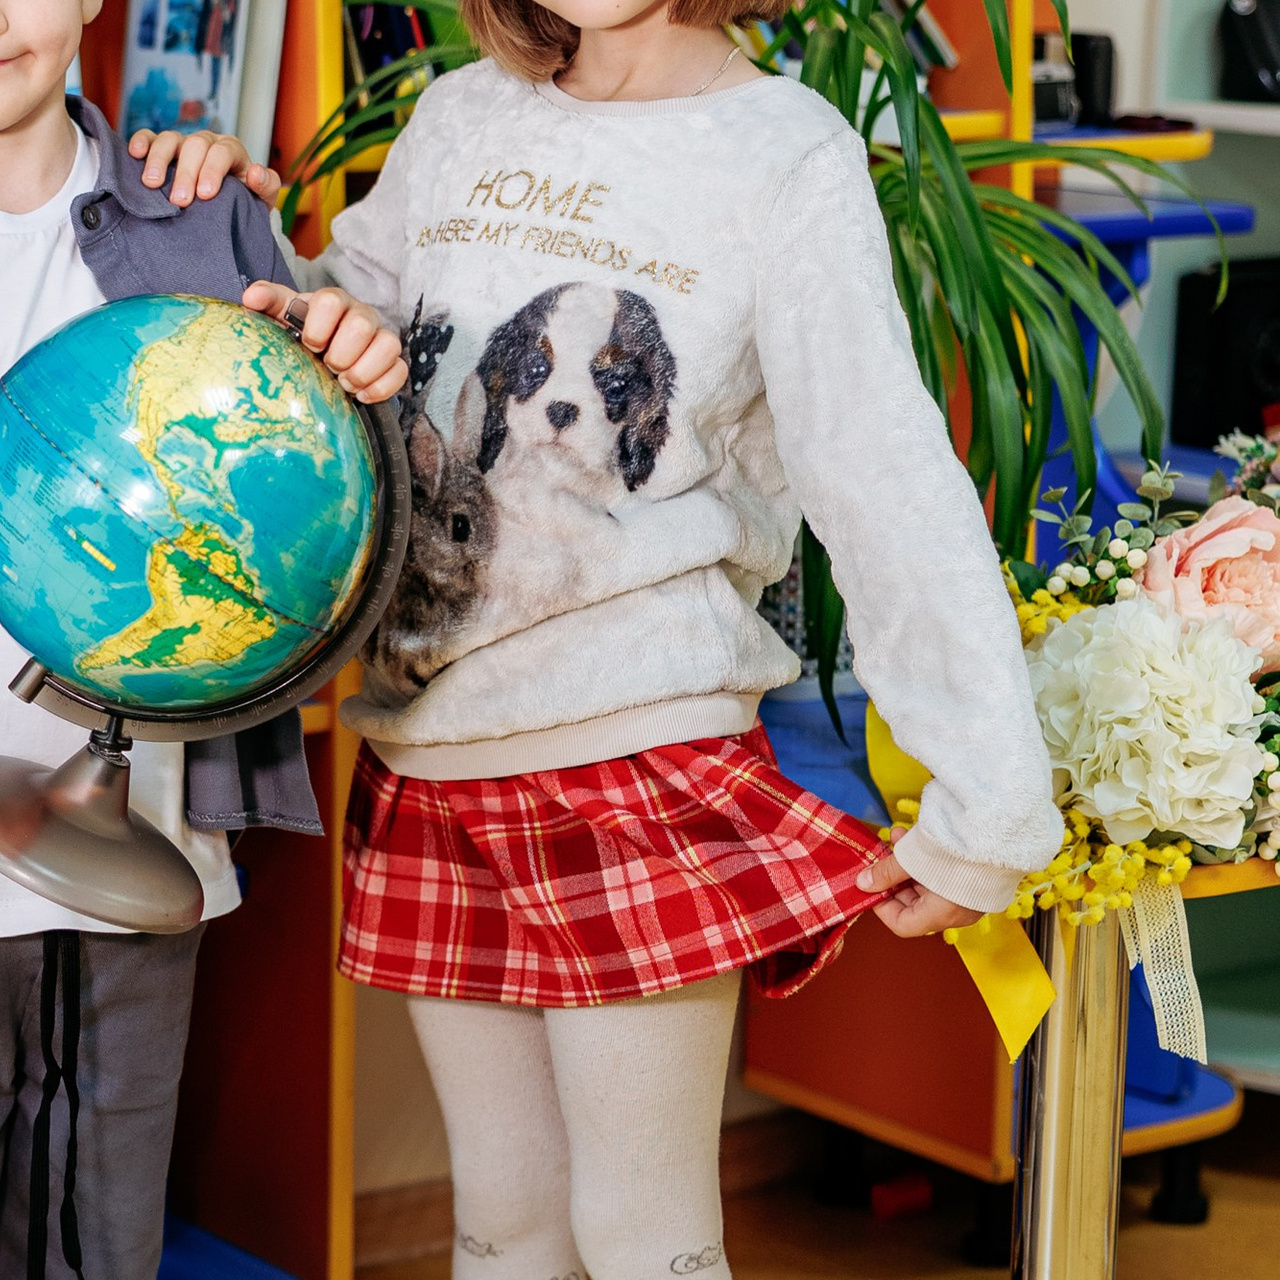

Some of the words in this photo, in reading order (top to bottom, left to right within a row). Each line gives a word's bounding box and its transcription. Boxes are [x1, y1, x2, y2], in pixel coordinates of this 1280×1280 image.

[466, 169, 612, 223] HOME
[477, 220, 519, 247] MY
[520, 225, 633, 271] FRIENDS
[634, 259, 700, 295] ARE
